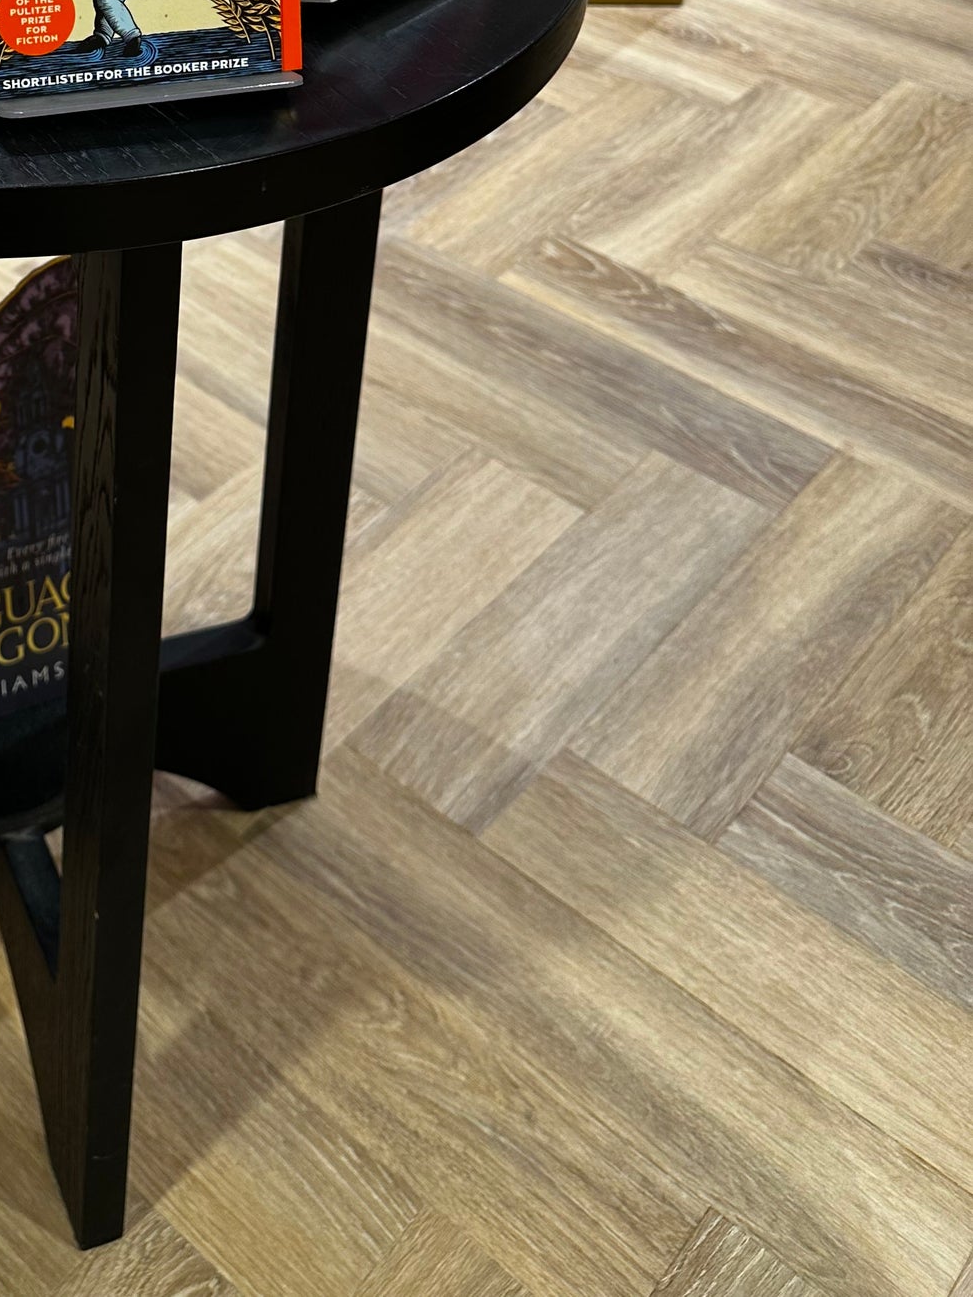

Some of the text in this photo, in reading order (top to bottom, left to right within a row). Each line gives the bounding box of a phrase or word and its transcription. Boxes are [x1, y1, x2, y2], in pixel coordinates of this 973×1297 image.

[9, 4, 62, 17] PULITZER
[20, 15, 52, 25] PRIZE
[25, 24, 48, 35] FOR
[15, 34, 58, 45] FICTION
[2, 57, 249, 90] SHORTLISTED FOR THE BOOKER PRIZE
